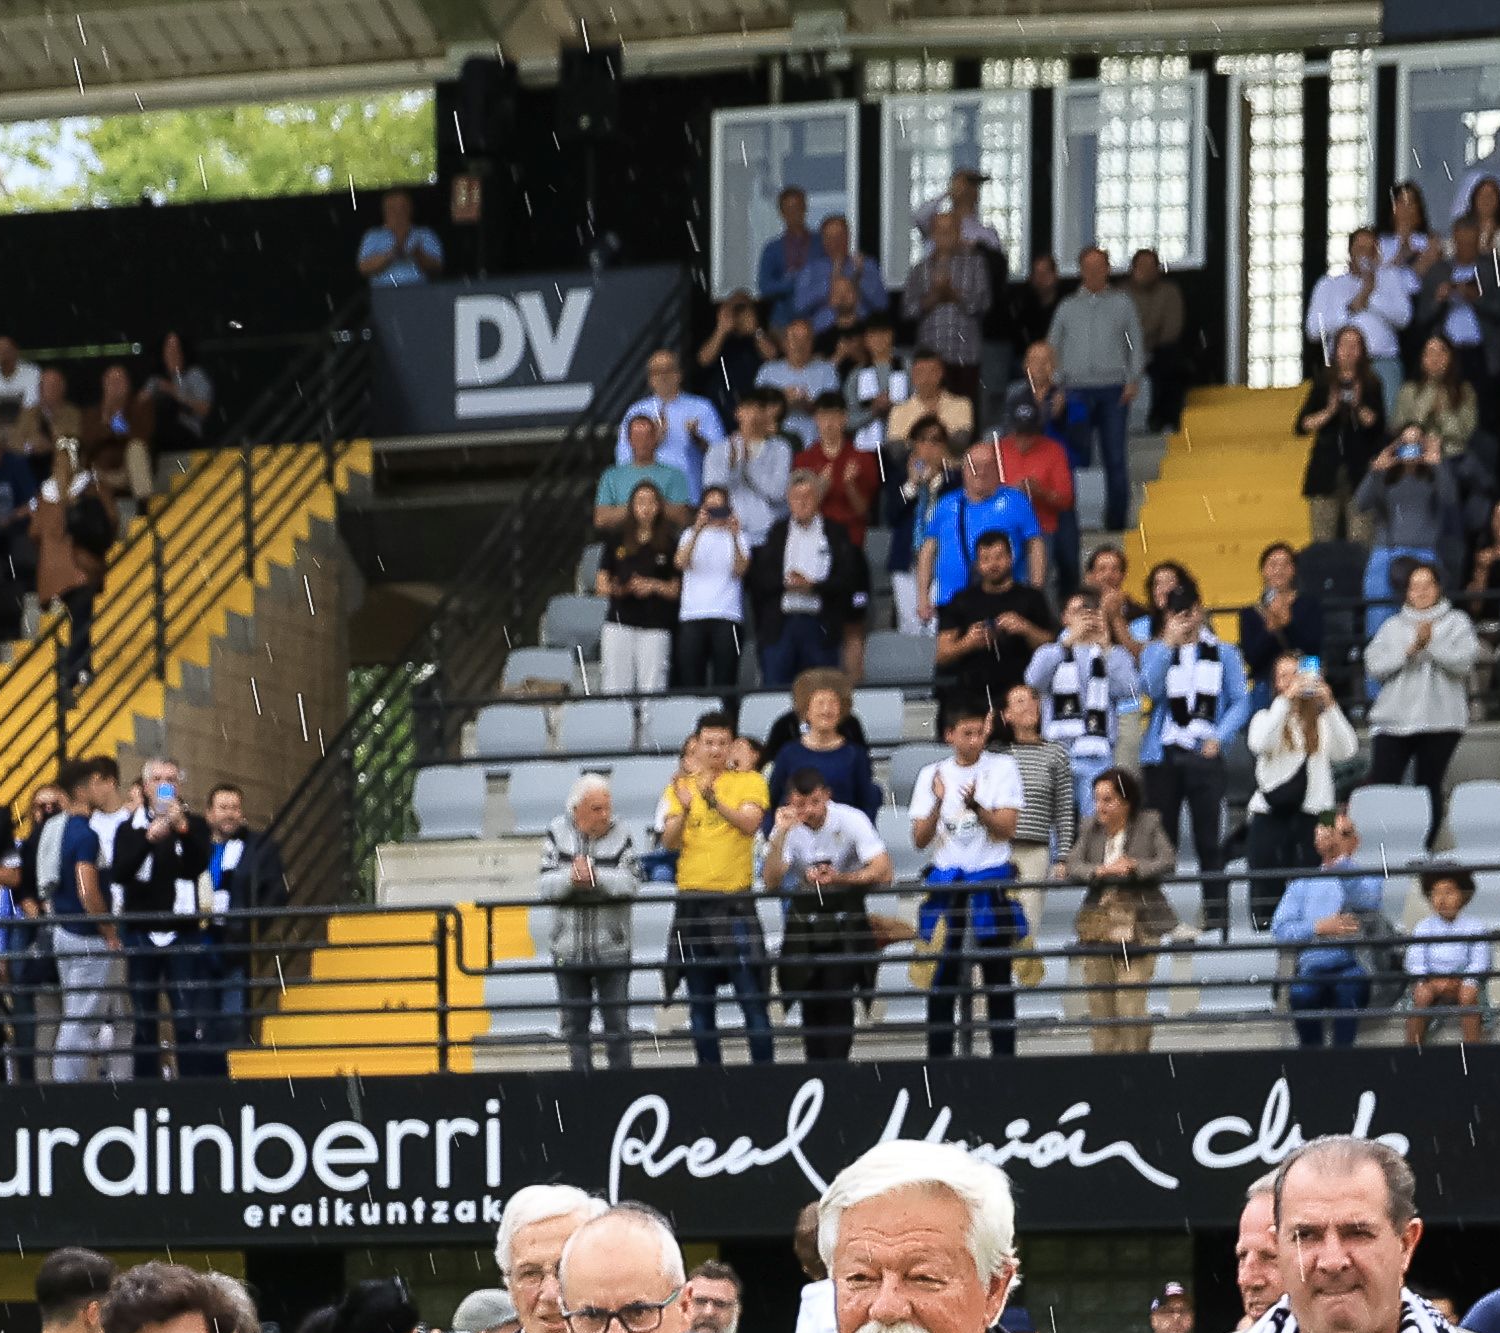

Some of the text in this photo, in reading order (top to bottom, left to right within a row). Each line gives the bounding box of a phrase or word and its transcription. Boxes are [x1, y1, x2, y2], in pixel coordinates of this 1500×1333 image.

[455, 287, 594, 389] DV
[609, 1078, 828, 1206] Real
[243, 1196, 502, 1228] eraikuntzak
